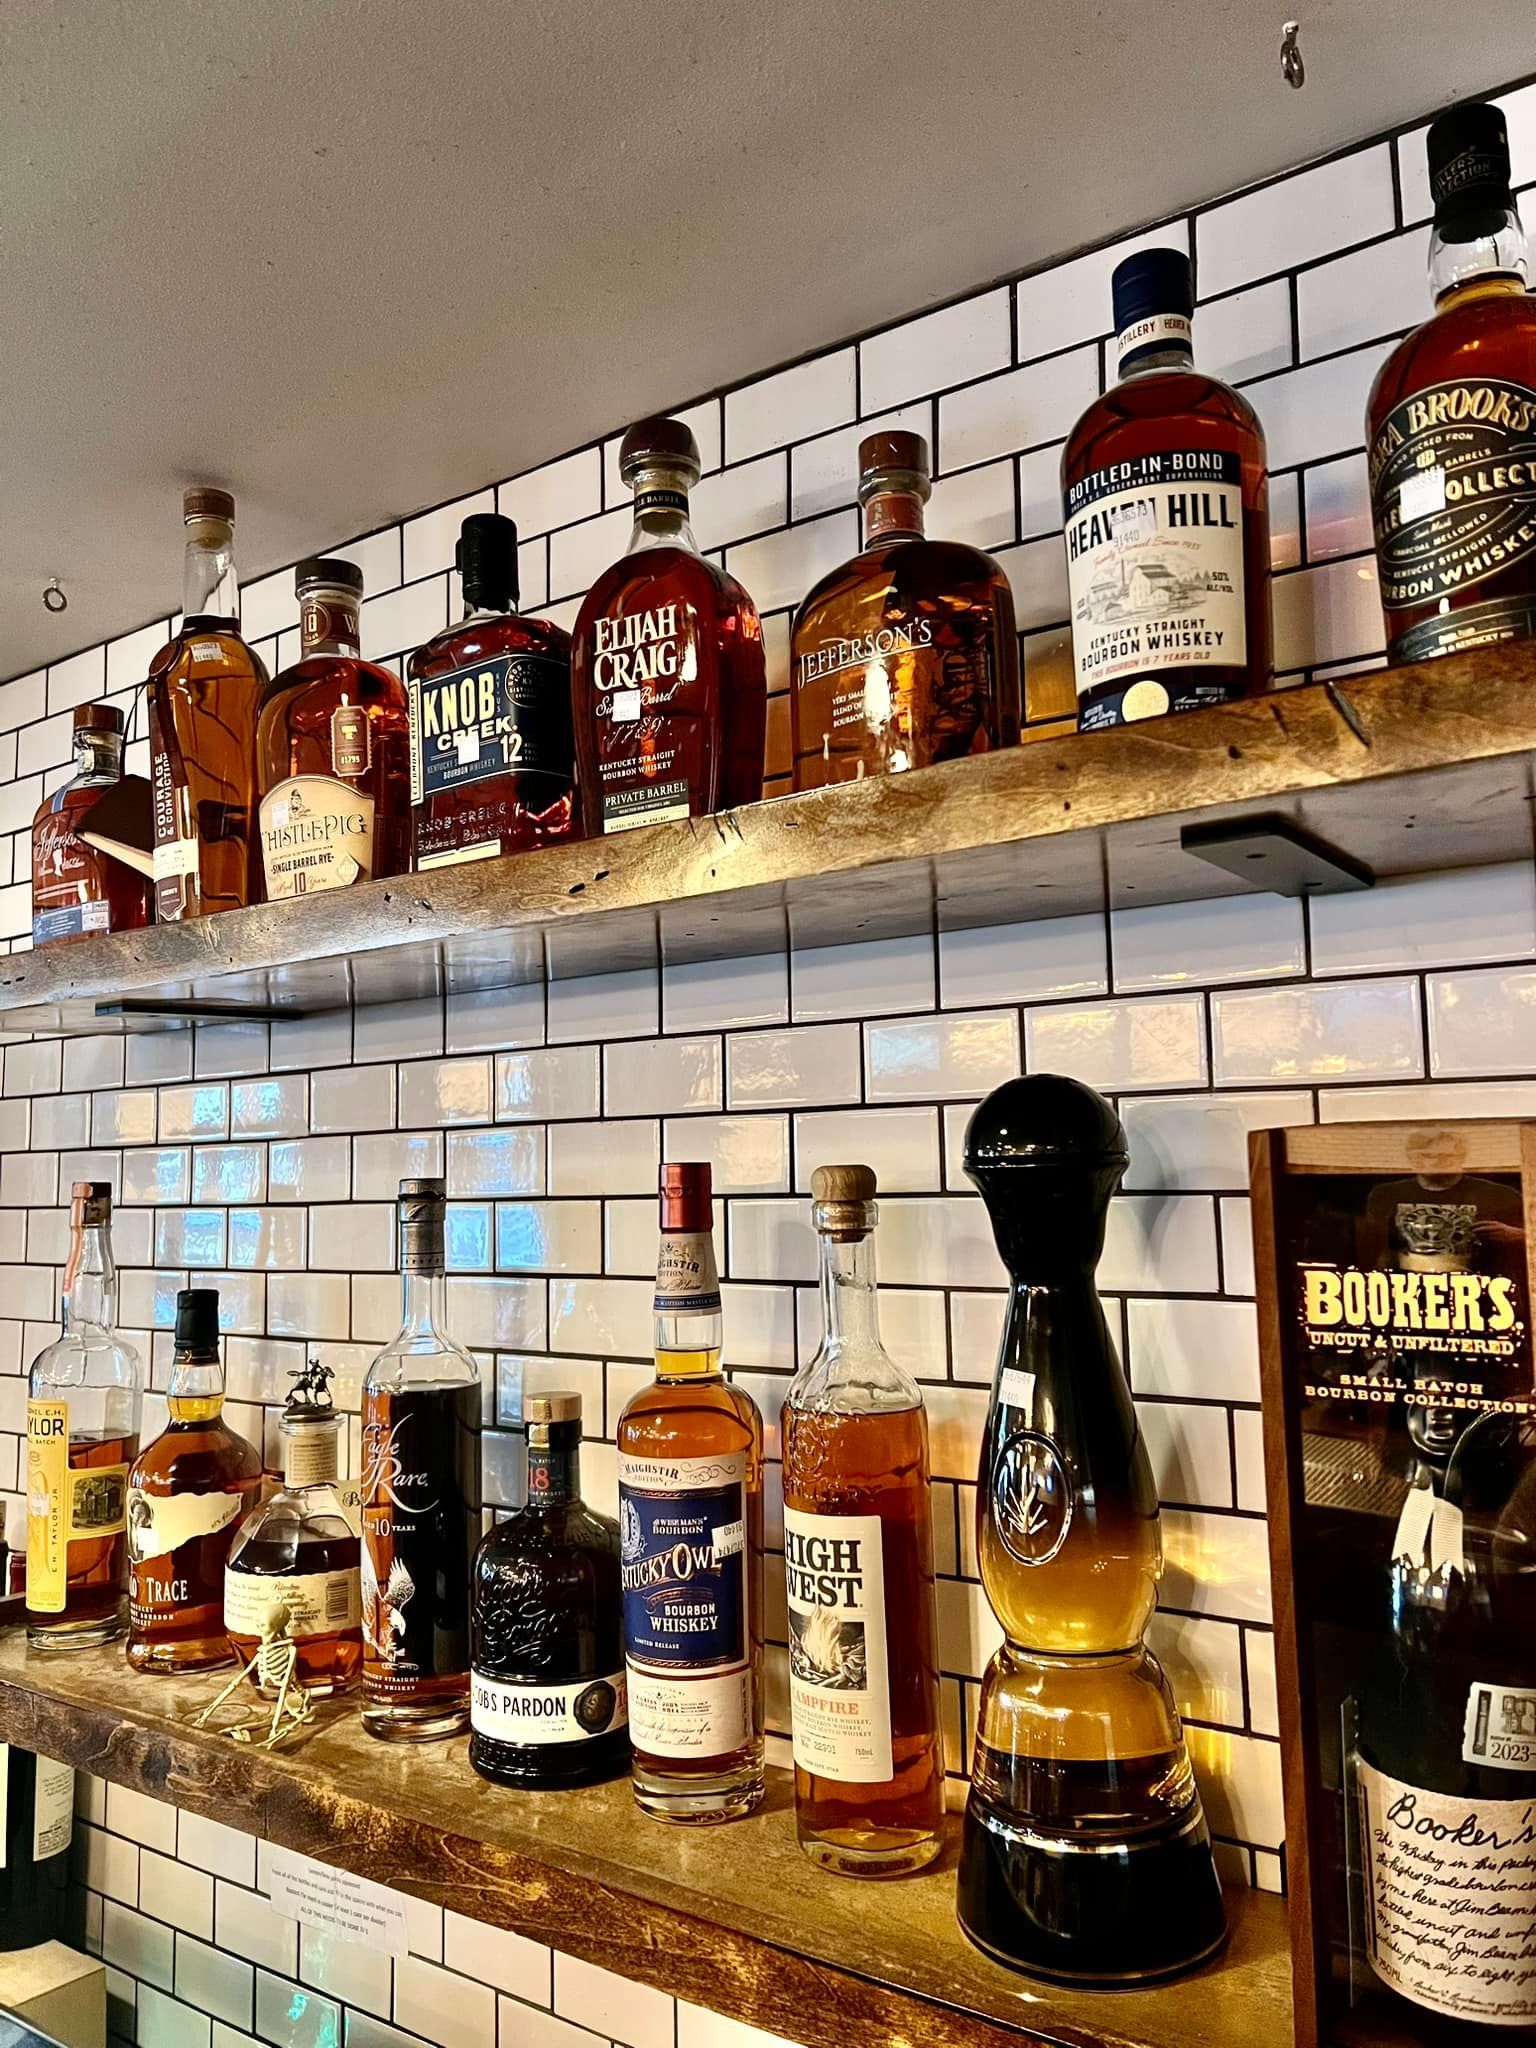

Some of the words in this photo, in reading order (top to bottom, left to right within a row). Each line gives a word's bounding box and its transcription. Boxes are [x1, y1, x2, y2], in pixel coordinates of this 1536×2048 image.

[1119, 321, 1156, 348] STILLERY
[1445, 432, 1474, 442] FROM
[1444, 447, 1492, 469] BARRELS
[1069, 452, 1224, 505] BOTTLED-IN-BOND
[1446, 461, 1536, 501] OLLECT
[1069, 497, 1158, 562] HEAV
[1167, 493, 1238, 528] HILL
[1433, 512, 1488, 546] MELLOWED
[1438, 533, 1493, 567] STRAIGHT
[1384, 577, 1434, 600] URBON
[593, 604, 678, 656] ELIJAH
[1091, 626, 1140, 650] KENTUCKY
[1146, 618, 1206, 634] STRAIGHT
[797, 616, 933, 689] JEFFERSON'S
[1082, 639, 1141, 672] BOURBON
[1147, 631, 1224, 650] WHISKEY
[1163, 652, 1191, 663] YEARS
[1193, 651, 1211, 661] OLD
[593, 640, 678, 691] CRAIG
[424, 672, 495, 738] KNOB
[500, 732, 523, 764] 12
[599, 757, 636, 772] KENTUCKY
[638, 749, 676, 764] STRAIGHT
[602, 767, 637, 780] BOURBON
[638, 760, 672, 774] WHISKEY
[154, 753, 168, 839] COURAGE
[605, 790, 645, 807] PRIVATE
[647, 782, 687, 799] BARREL
[167, 824, 175, 836] &
[262, 813, 368, 852] HISTLEPIG
[272, 857, 292, 875] SINGLE
[292, 853, 317, 870] BARREL
[319, 851, 332, 864] RYE
[294, 871, 306, 894] 10
[1304, 1270, 1516, 1331] BOOKER'S
[1309, 1330, 1371, 1348] UNCUT
[1374, 1335, 1388, 1348] &
[1391, 1336, 1515, 1356] UNFILTERED
[1340, 1374, 1407, 1390] SMALL
[1414, 1379, 1484, 1395] BATCH
[1304, 1385, 1397, 1403] BOURBON
[1403, 1393, 1535, 1415] COLLECTION
[27, 1418, 64, 1436] YLOR
[362, 1455, 439, 1513] Rare
[529, 1467, 550, 1490] 18
[375, 1518, 390, 1537] 10
[391, 1524, 417, 1532] YEARS
[652, 1526, 704, 1535] BOURBON
[785, 1528, 863, 1573] HIGH
[622, 1552, 671, 1592] NTUCKY
[146, 1576, 188, 1603] TRACE
[786, 1567, 863, 1608] WEST
[664, 1603, 715, 1617] BOURBON
[650, 1615, 718, 1633] WHISKEY
[654, 1641, 680, 1650] RELEASE
[503, 1695, 566, 1717] PARDON
[1491, 1742, 1536, 1762] 2023-
[1387, 1792, 1536, 1850] Booker's
[1389, 1856, 1423, 1880] highest
[1423, 1872, 1460, 1888] grade
[1449, 1857, 1468, 1869] in
[1472, 1856, 1497, 1871] this
[1387, 1883, 1410, 1899] me
[1412, 1888, 1439, 1907] here
[1440, 1898, 1455, 1909] at
[1450, 1899, 1484, 1916] Jim
[1412, 1918, 1465, 1938] uncut
[1450, 1941, 1479, 1961] Jim
[1480, 1946, 1517, 1961] Beam
[1404, 1951, 1431, 1971] from
[1433, 1961, 1459, 1977] six
[1460, 1964, 1478, 1978] to
[1478, 1968, 1515, 1986] eight
